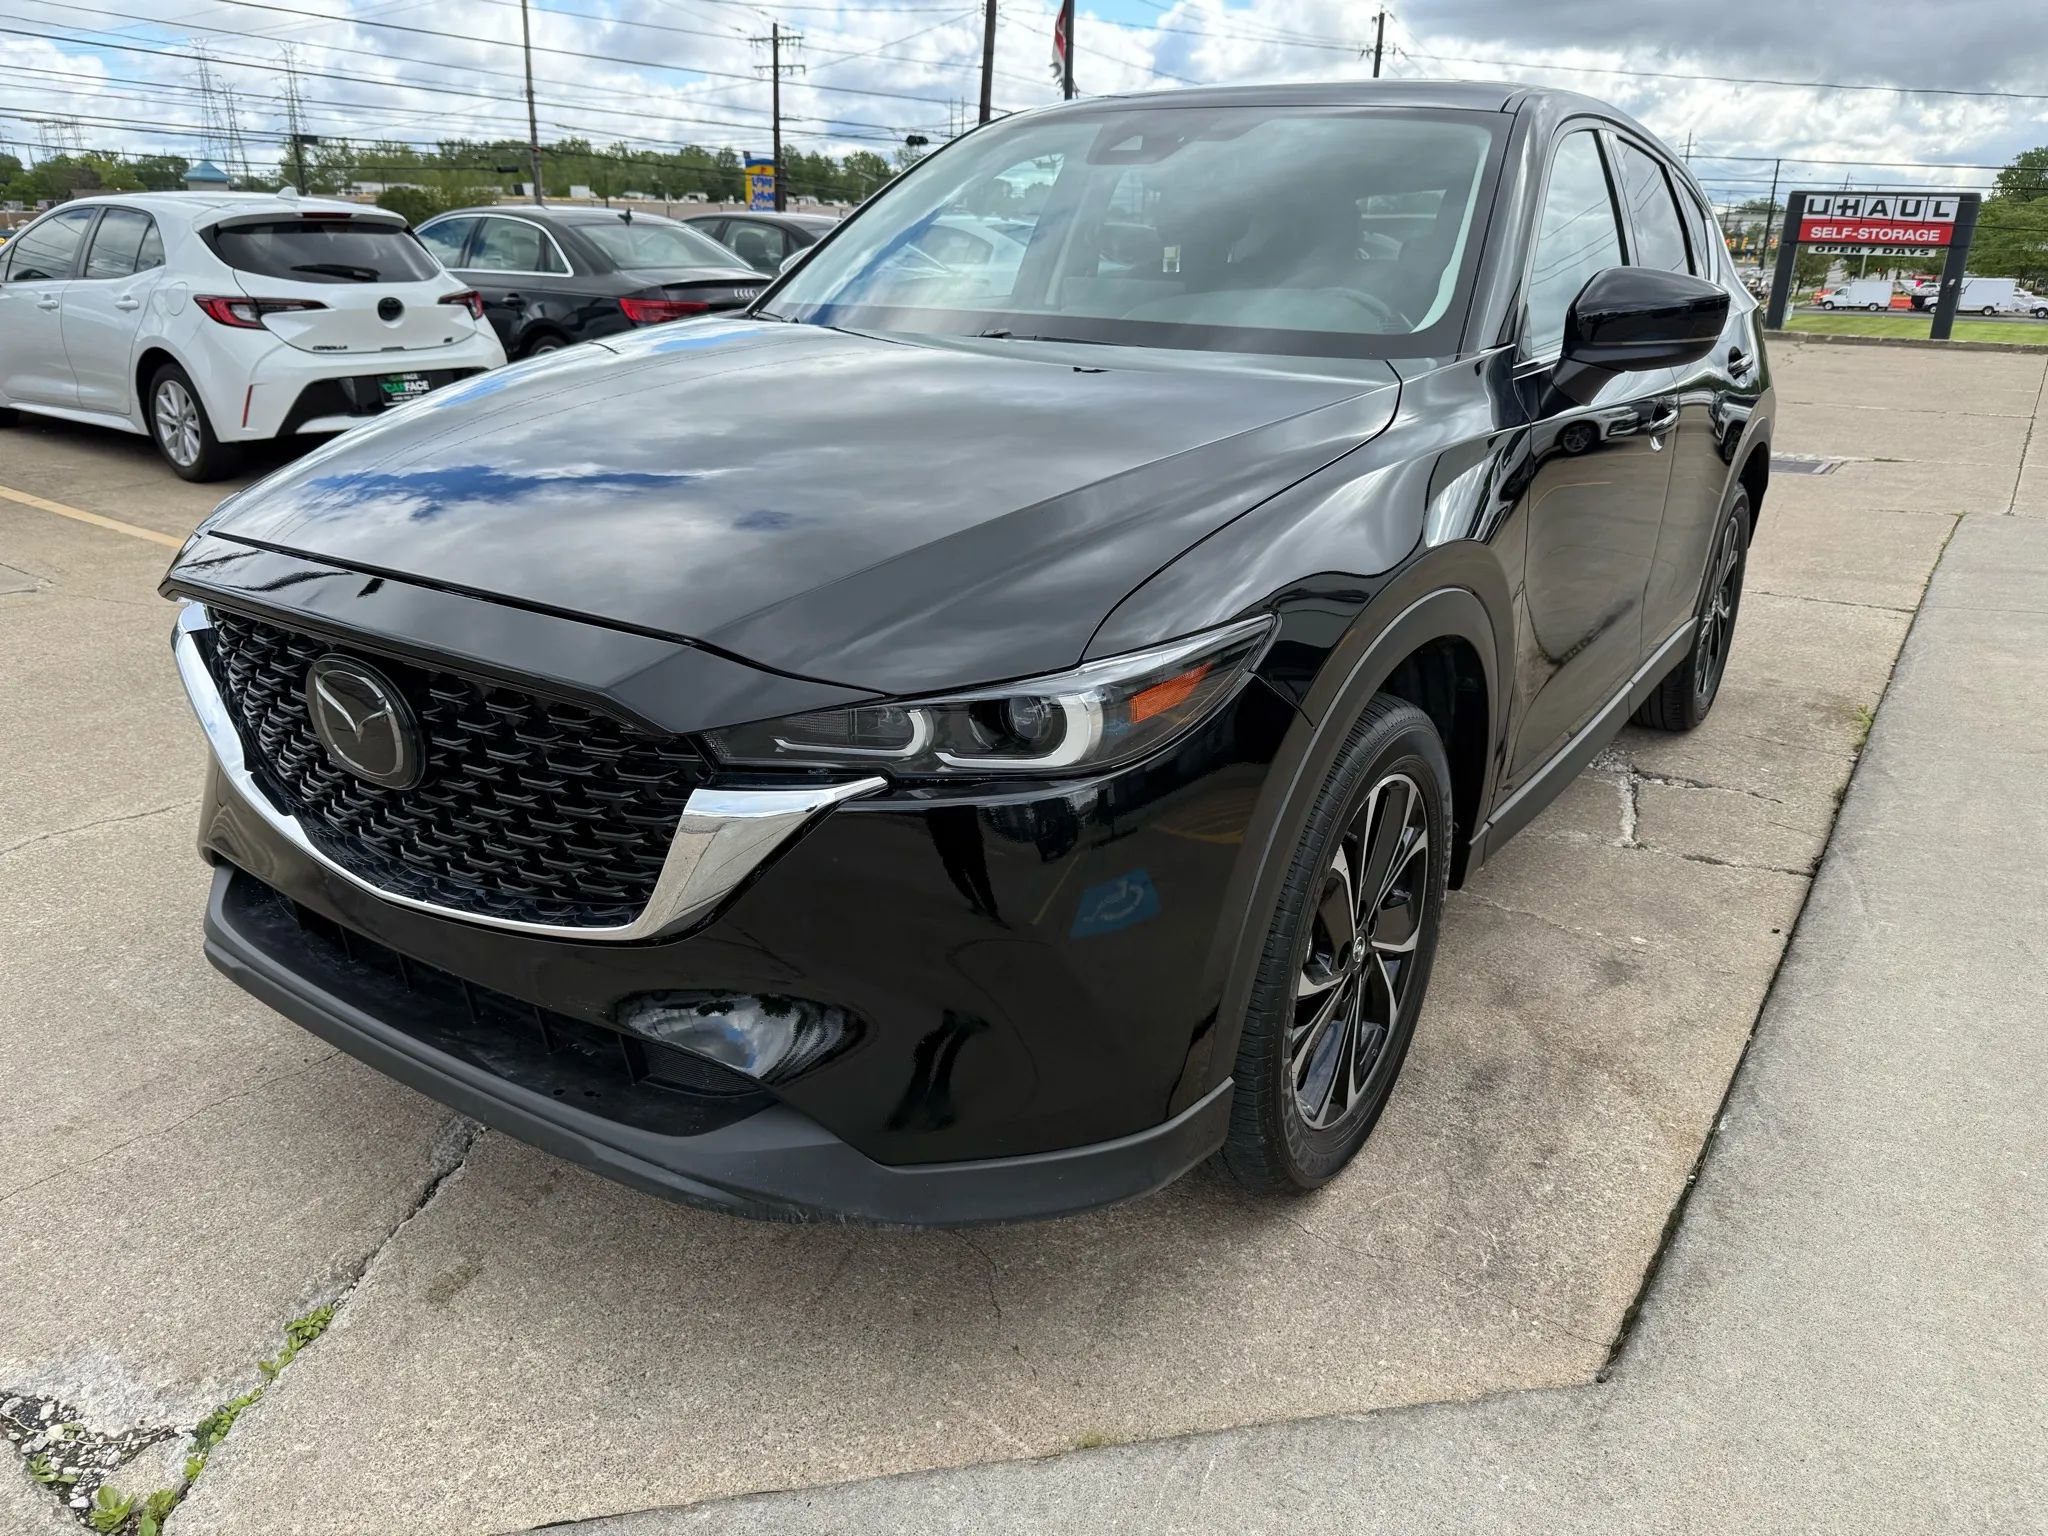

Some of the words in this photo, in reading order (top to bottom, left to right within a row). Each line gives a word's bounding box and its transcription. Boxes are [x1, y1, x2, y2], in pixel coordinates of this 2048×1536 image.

[1810, 227, 1941, 242] SELF-STORAGE
[1814, 246, 1862, 254] OPEN
[1868, 246, 1877, 254] 7
[1881, 247, 1930, 256] DAYS
